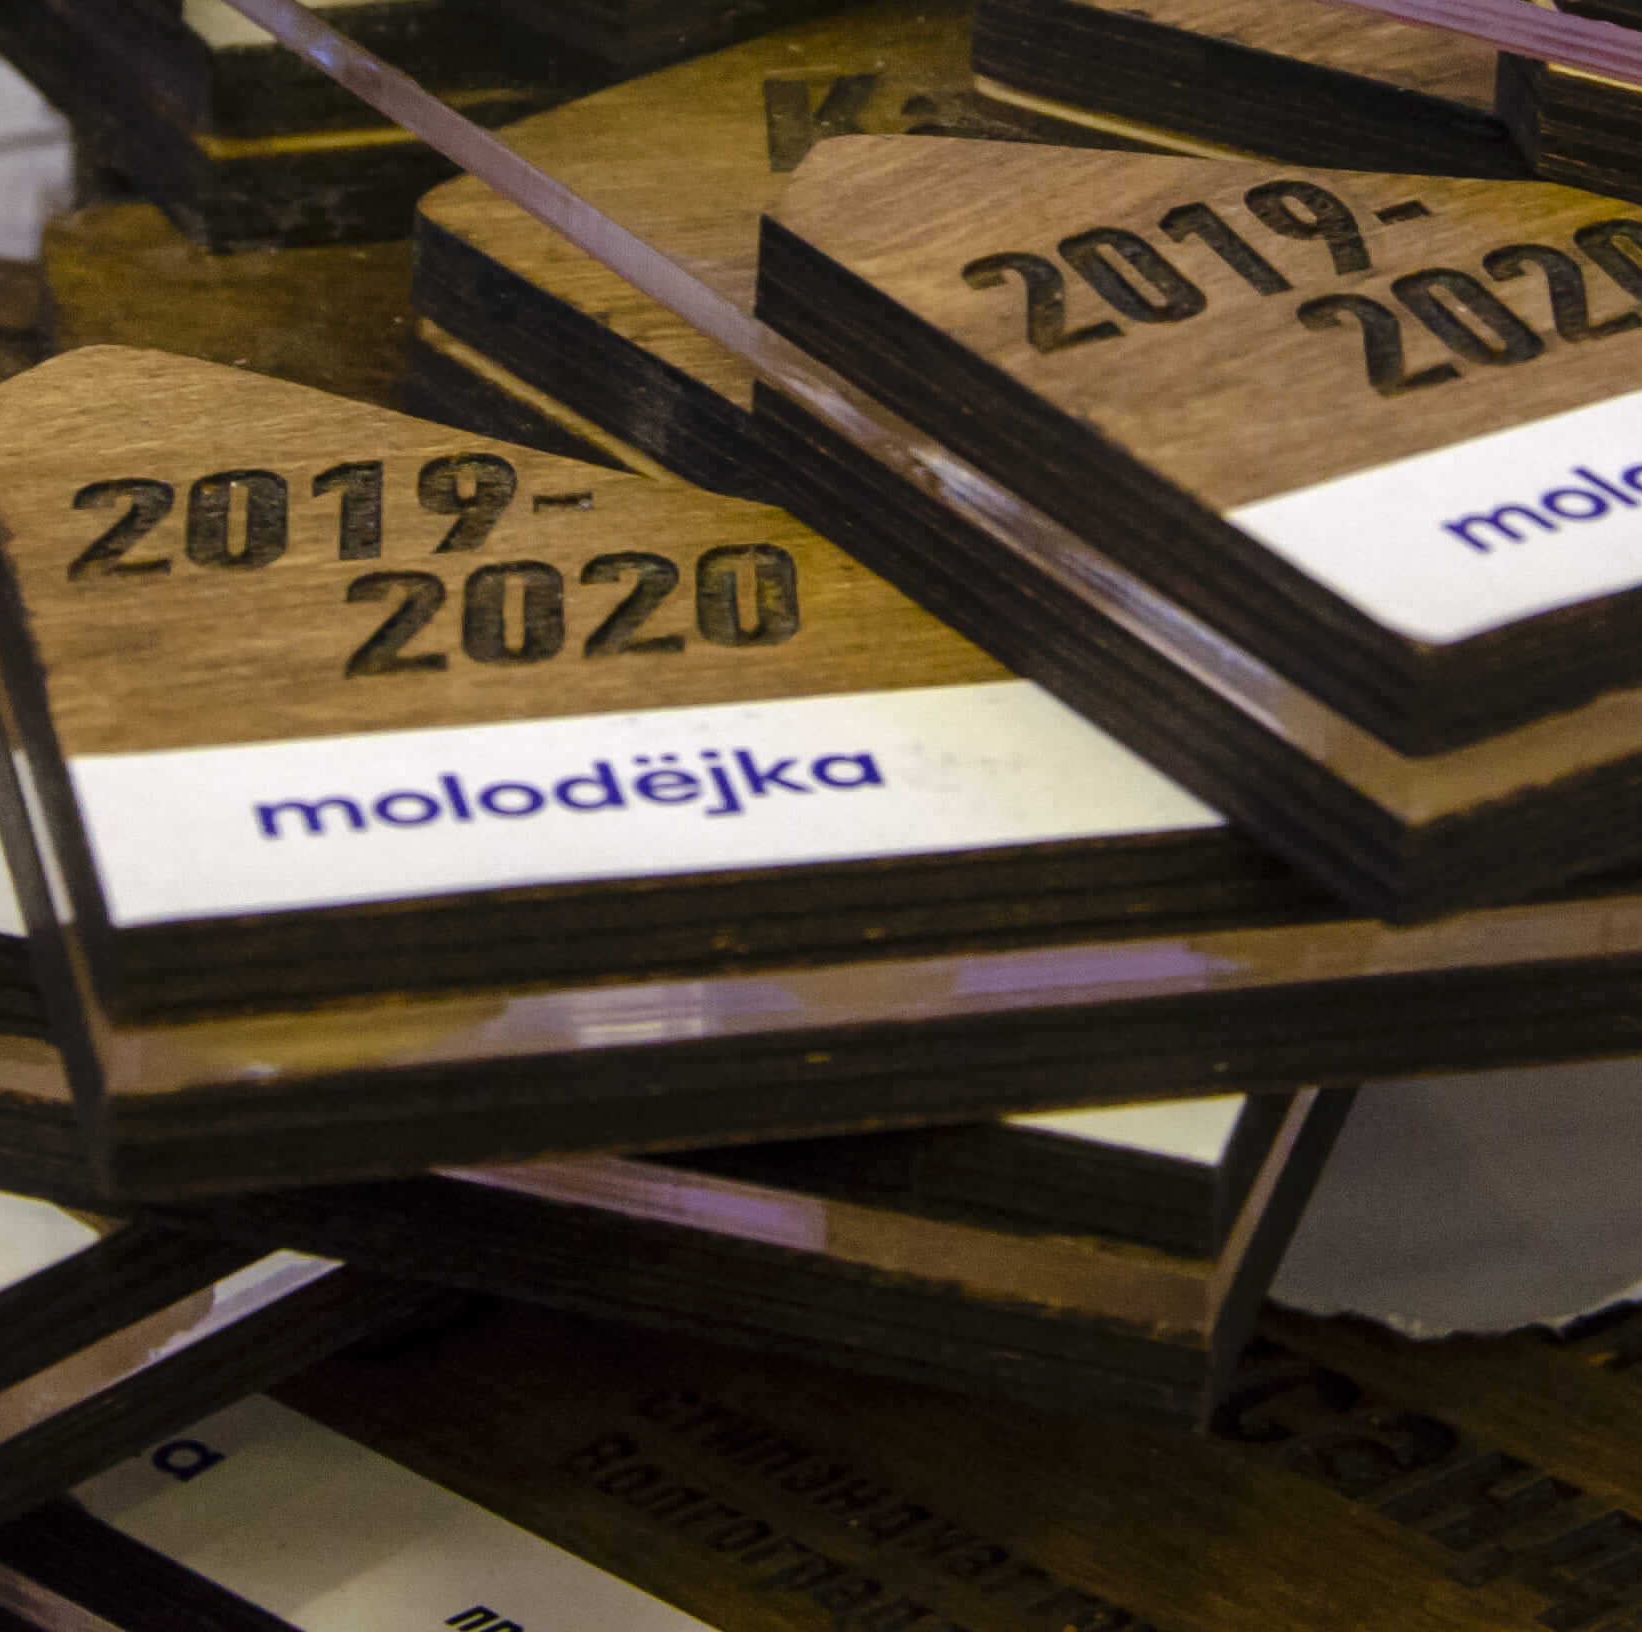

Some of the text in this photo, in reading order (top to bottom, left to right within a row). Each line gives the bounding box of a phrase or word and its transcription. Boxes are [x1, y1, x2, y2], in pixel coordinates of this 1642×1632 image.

[961, 177, 1435, 355] 2019-
[66, 451, 595, 582] 2019-
[342, 540, 802, 680] 2020
[253, 746, 887, 841] molodëjka
